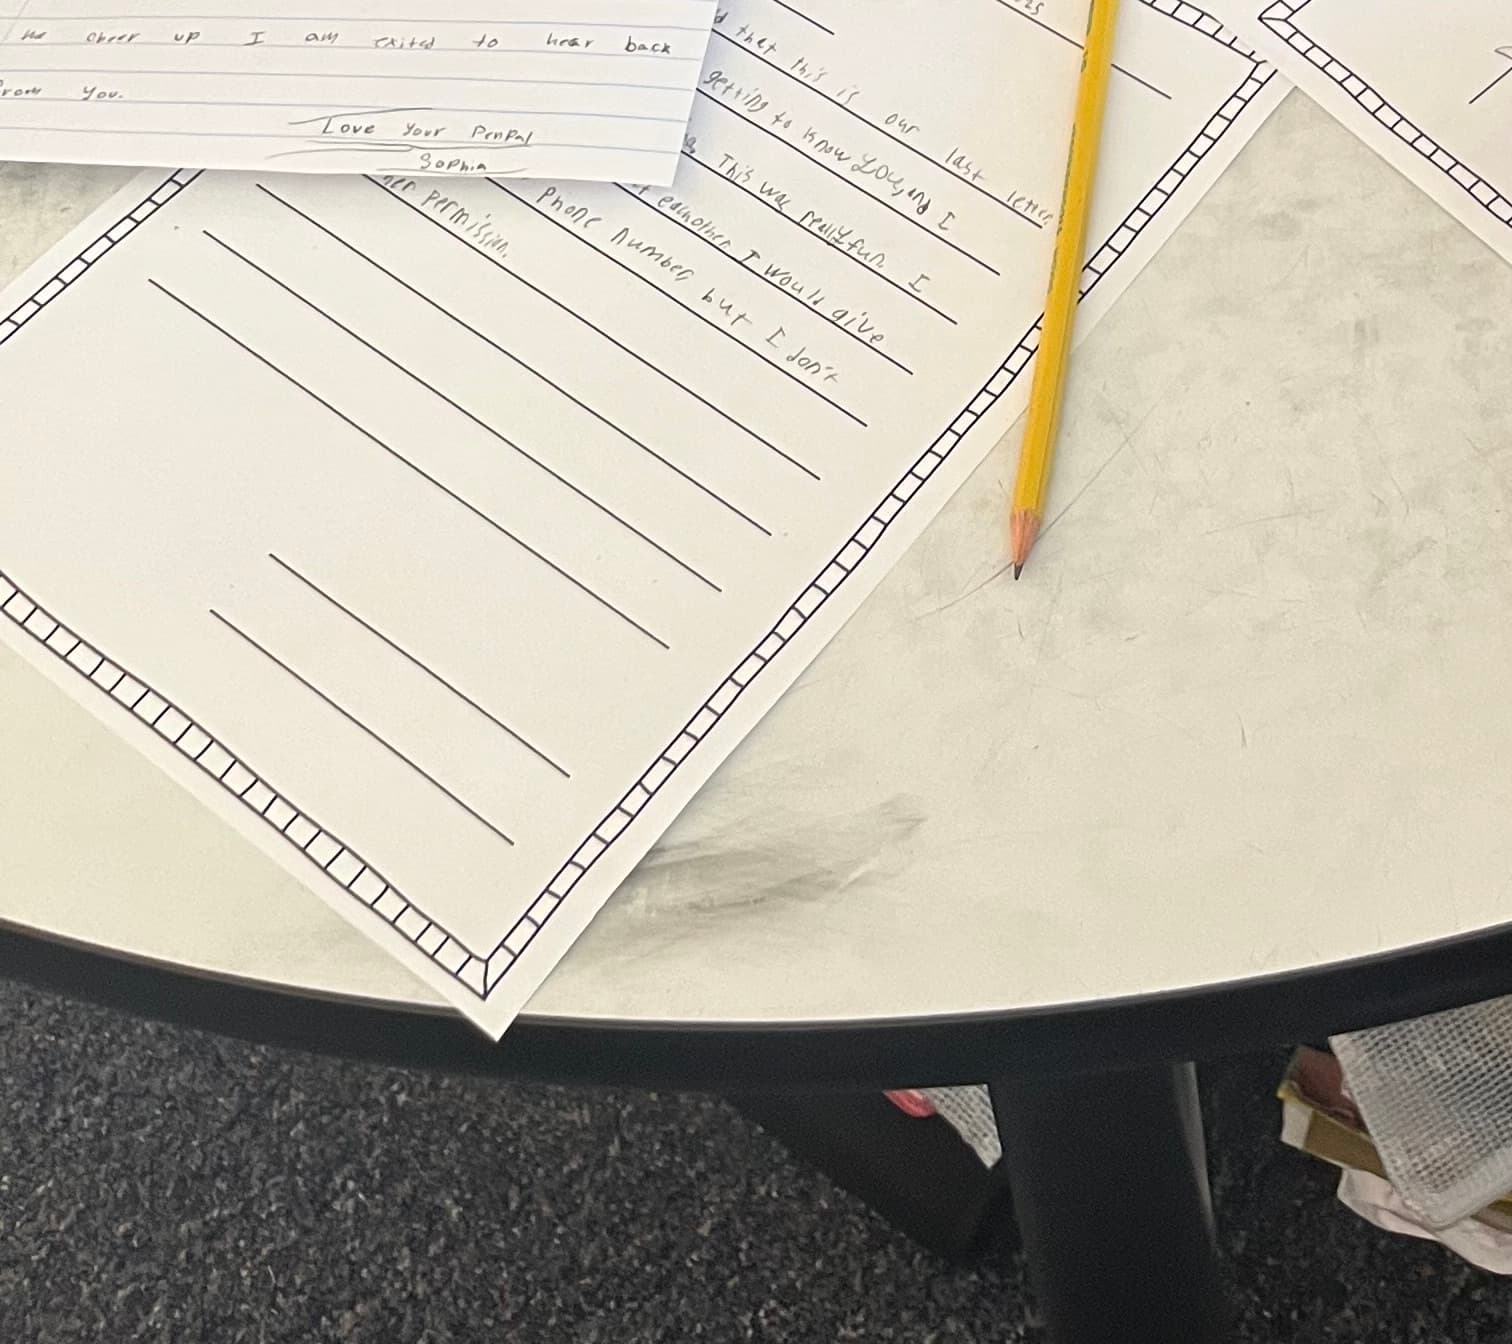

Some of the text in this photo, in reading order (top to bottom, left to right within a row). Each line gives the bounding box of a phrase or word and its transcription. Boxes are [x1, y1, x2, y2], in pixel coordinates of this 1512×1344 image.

[248, 29, 267, 47] I
[472, 34, 500, 51] to
[624, 35, 672, 56] back
[321, 115, 377, 139] Love
[703, 69, 769, 111] getting
[773, 111, 792, 130] to
[937, 211, 957, 232] I
[735, 24, 778, 54] that
[790, 55, 828, 84] this
[836, 84, 862, 107] is
[883, 112, 921, 136] our
[944, 146, 985, 182] last
[717, 151, 753, 184] This
[908, 272, 930, 295] I
[701, 287, 753, 328] but
[765, 325, 787, 348] I
[785, 346, 839, 384] don't
[831, 306, 886, 346] give
